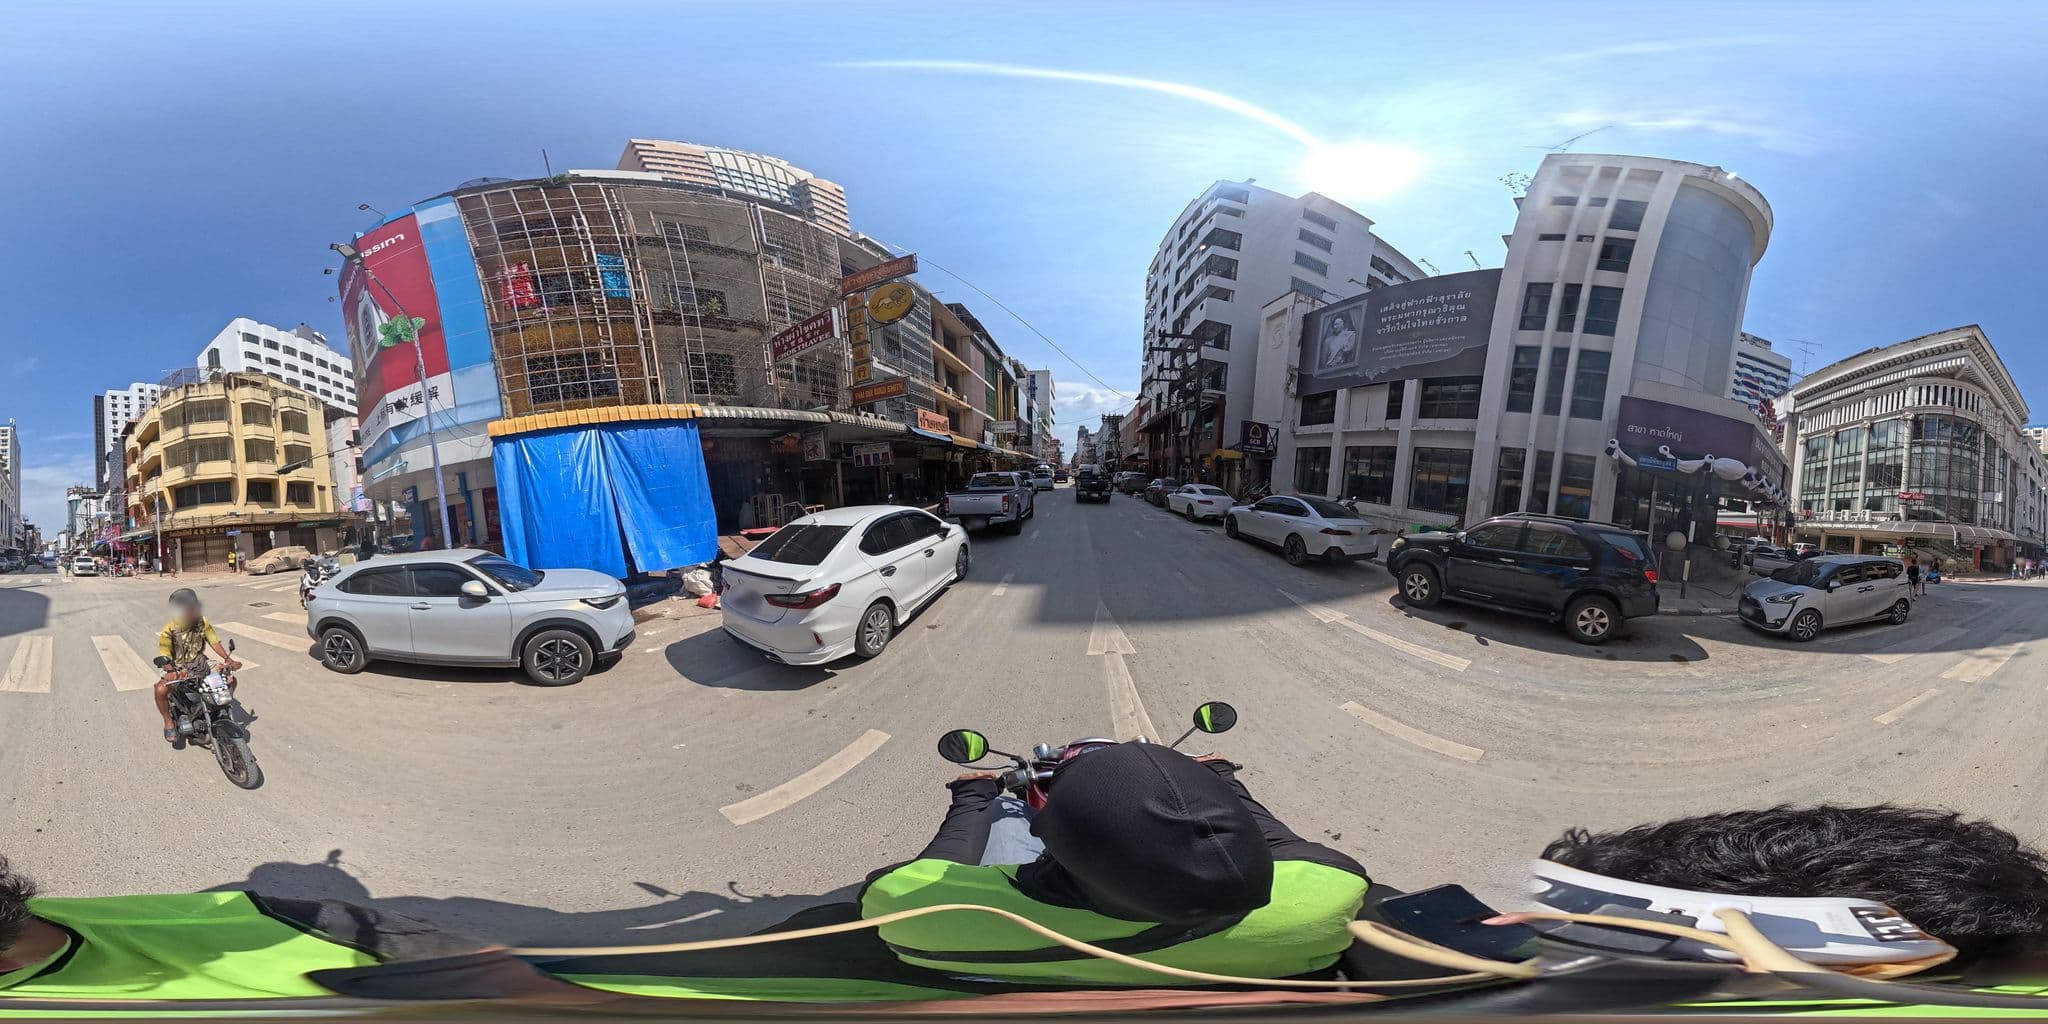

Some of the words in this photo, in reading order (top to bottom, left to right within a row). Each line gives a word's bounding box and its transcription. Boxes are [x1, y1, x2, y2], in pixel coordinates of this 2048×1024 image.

[1627, 424, 1647, 434] สาขา
[1650, 426, 1683, 442] หาดใหญ่
